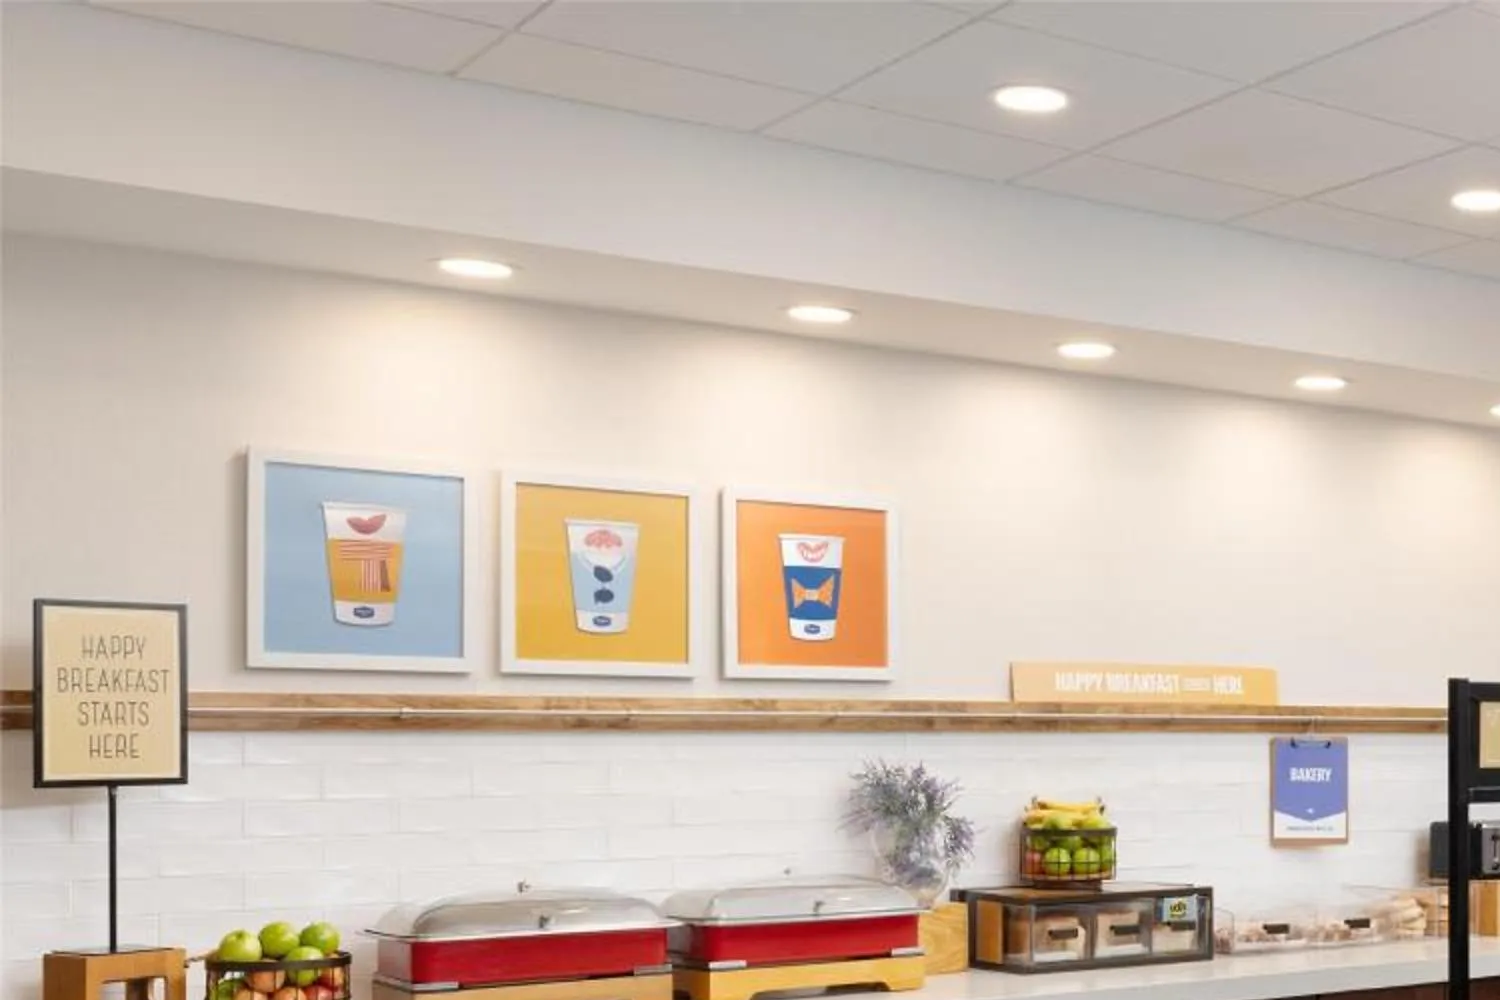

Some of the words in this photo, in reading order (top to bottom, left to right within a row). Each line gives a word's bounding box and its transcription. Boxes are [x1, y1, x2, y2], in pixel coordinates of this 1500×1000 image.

[81, 634, 147, 660] HAPPY
[57, 666, 170, 694] BREAKFAST
[77, 701, 150, 727] STARTS
[89, 733, 140, 759] HERE
[1289, 766, 1333, 783] BAKERY
